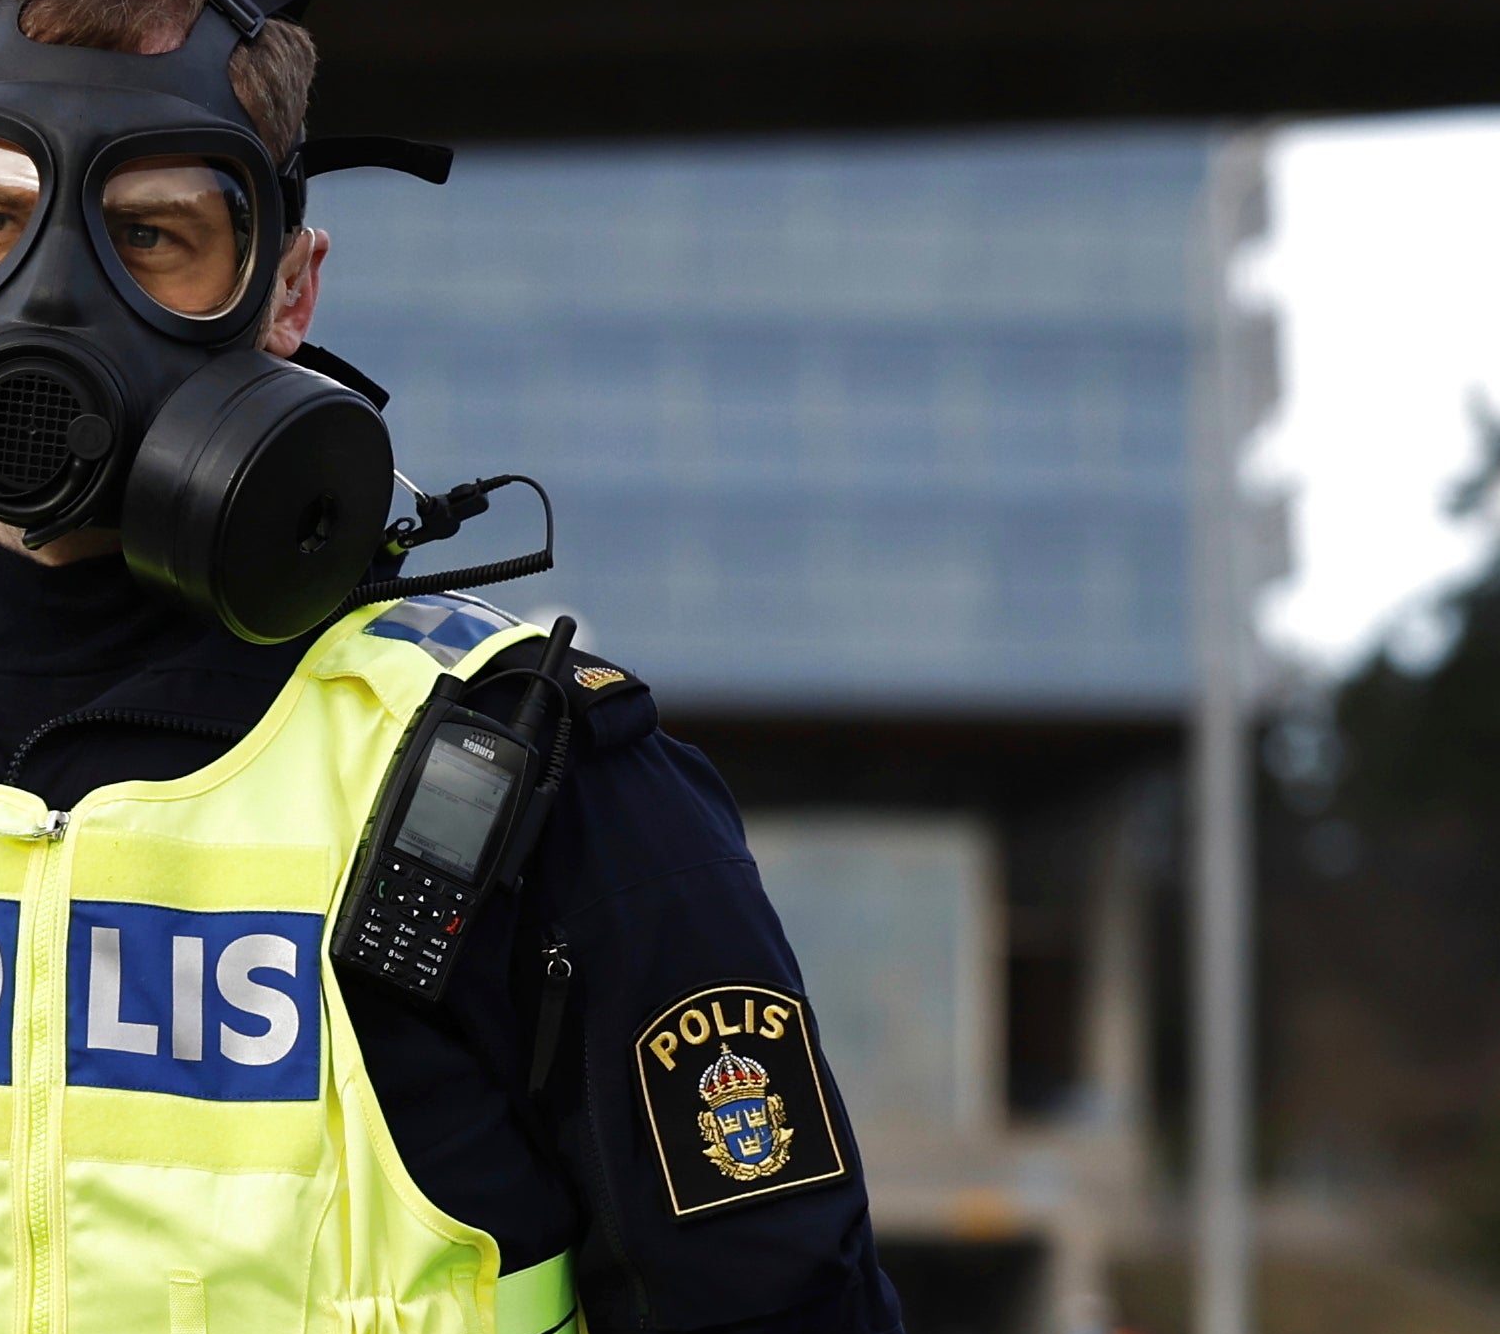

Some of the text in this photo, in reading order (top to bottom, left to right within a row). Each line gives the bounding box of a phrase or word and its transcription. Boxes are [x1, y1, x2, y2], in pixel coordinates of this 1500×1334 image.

[461, 737, 496, 762] sepura
[370, 908, 376, 916] 1
[648, 998, 790, 1072] POLIS
